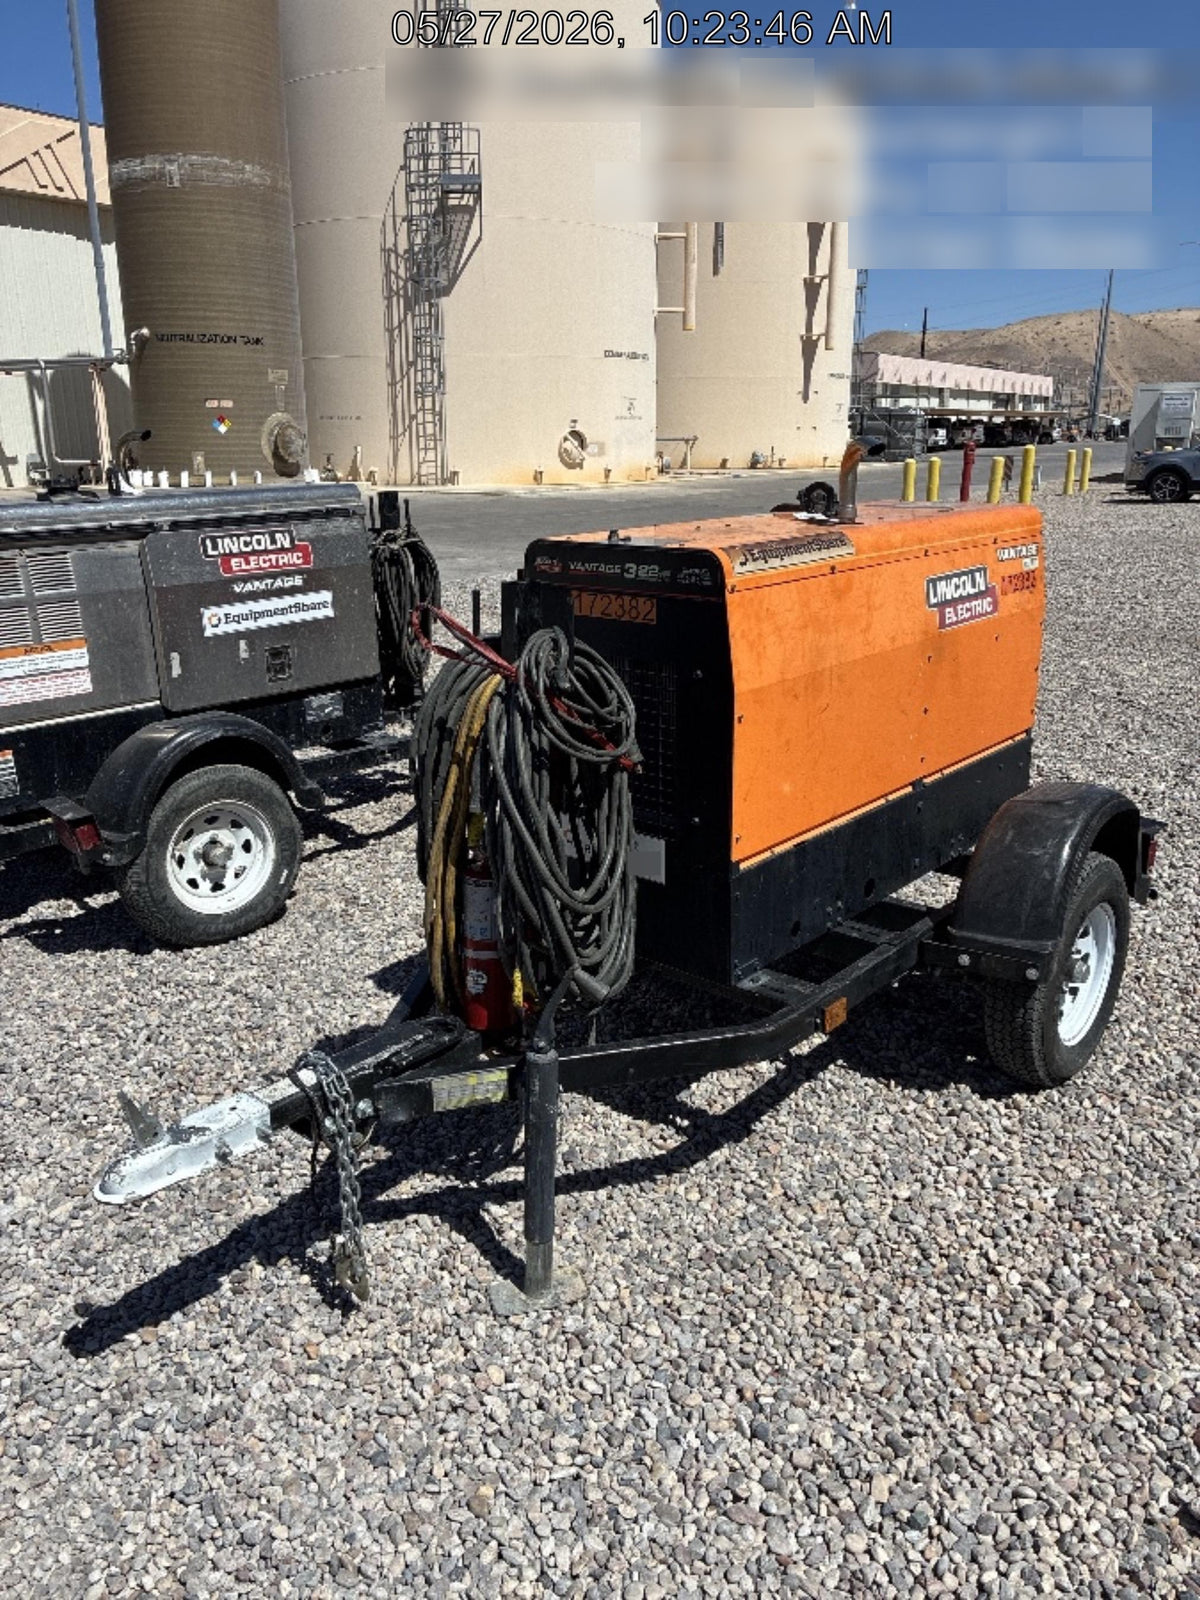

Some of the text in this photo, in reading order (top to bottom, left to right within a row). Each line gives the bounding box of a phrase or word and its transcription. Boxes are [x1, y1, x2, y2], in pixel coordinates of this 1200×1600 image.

[206, 533, 291, 555] LINCOLN
[230, 552, 303, 570] ELECTRIC
[569, 561, 621, 573] VANTAGE
[233, 575, 303, 592] VANTAGE
[929, 570, 986, 605] LINCOLN
[223, 599, 329, 624] EquipmentShare
[573, 592, 655, 622] 172382
[945, 597, 993, 624] ELECTRIC
